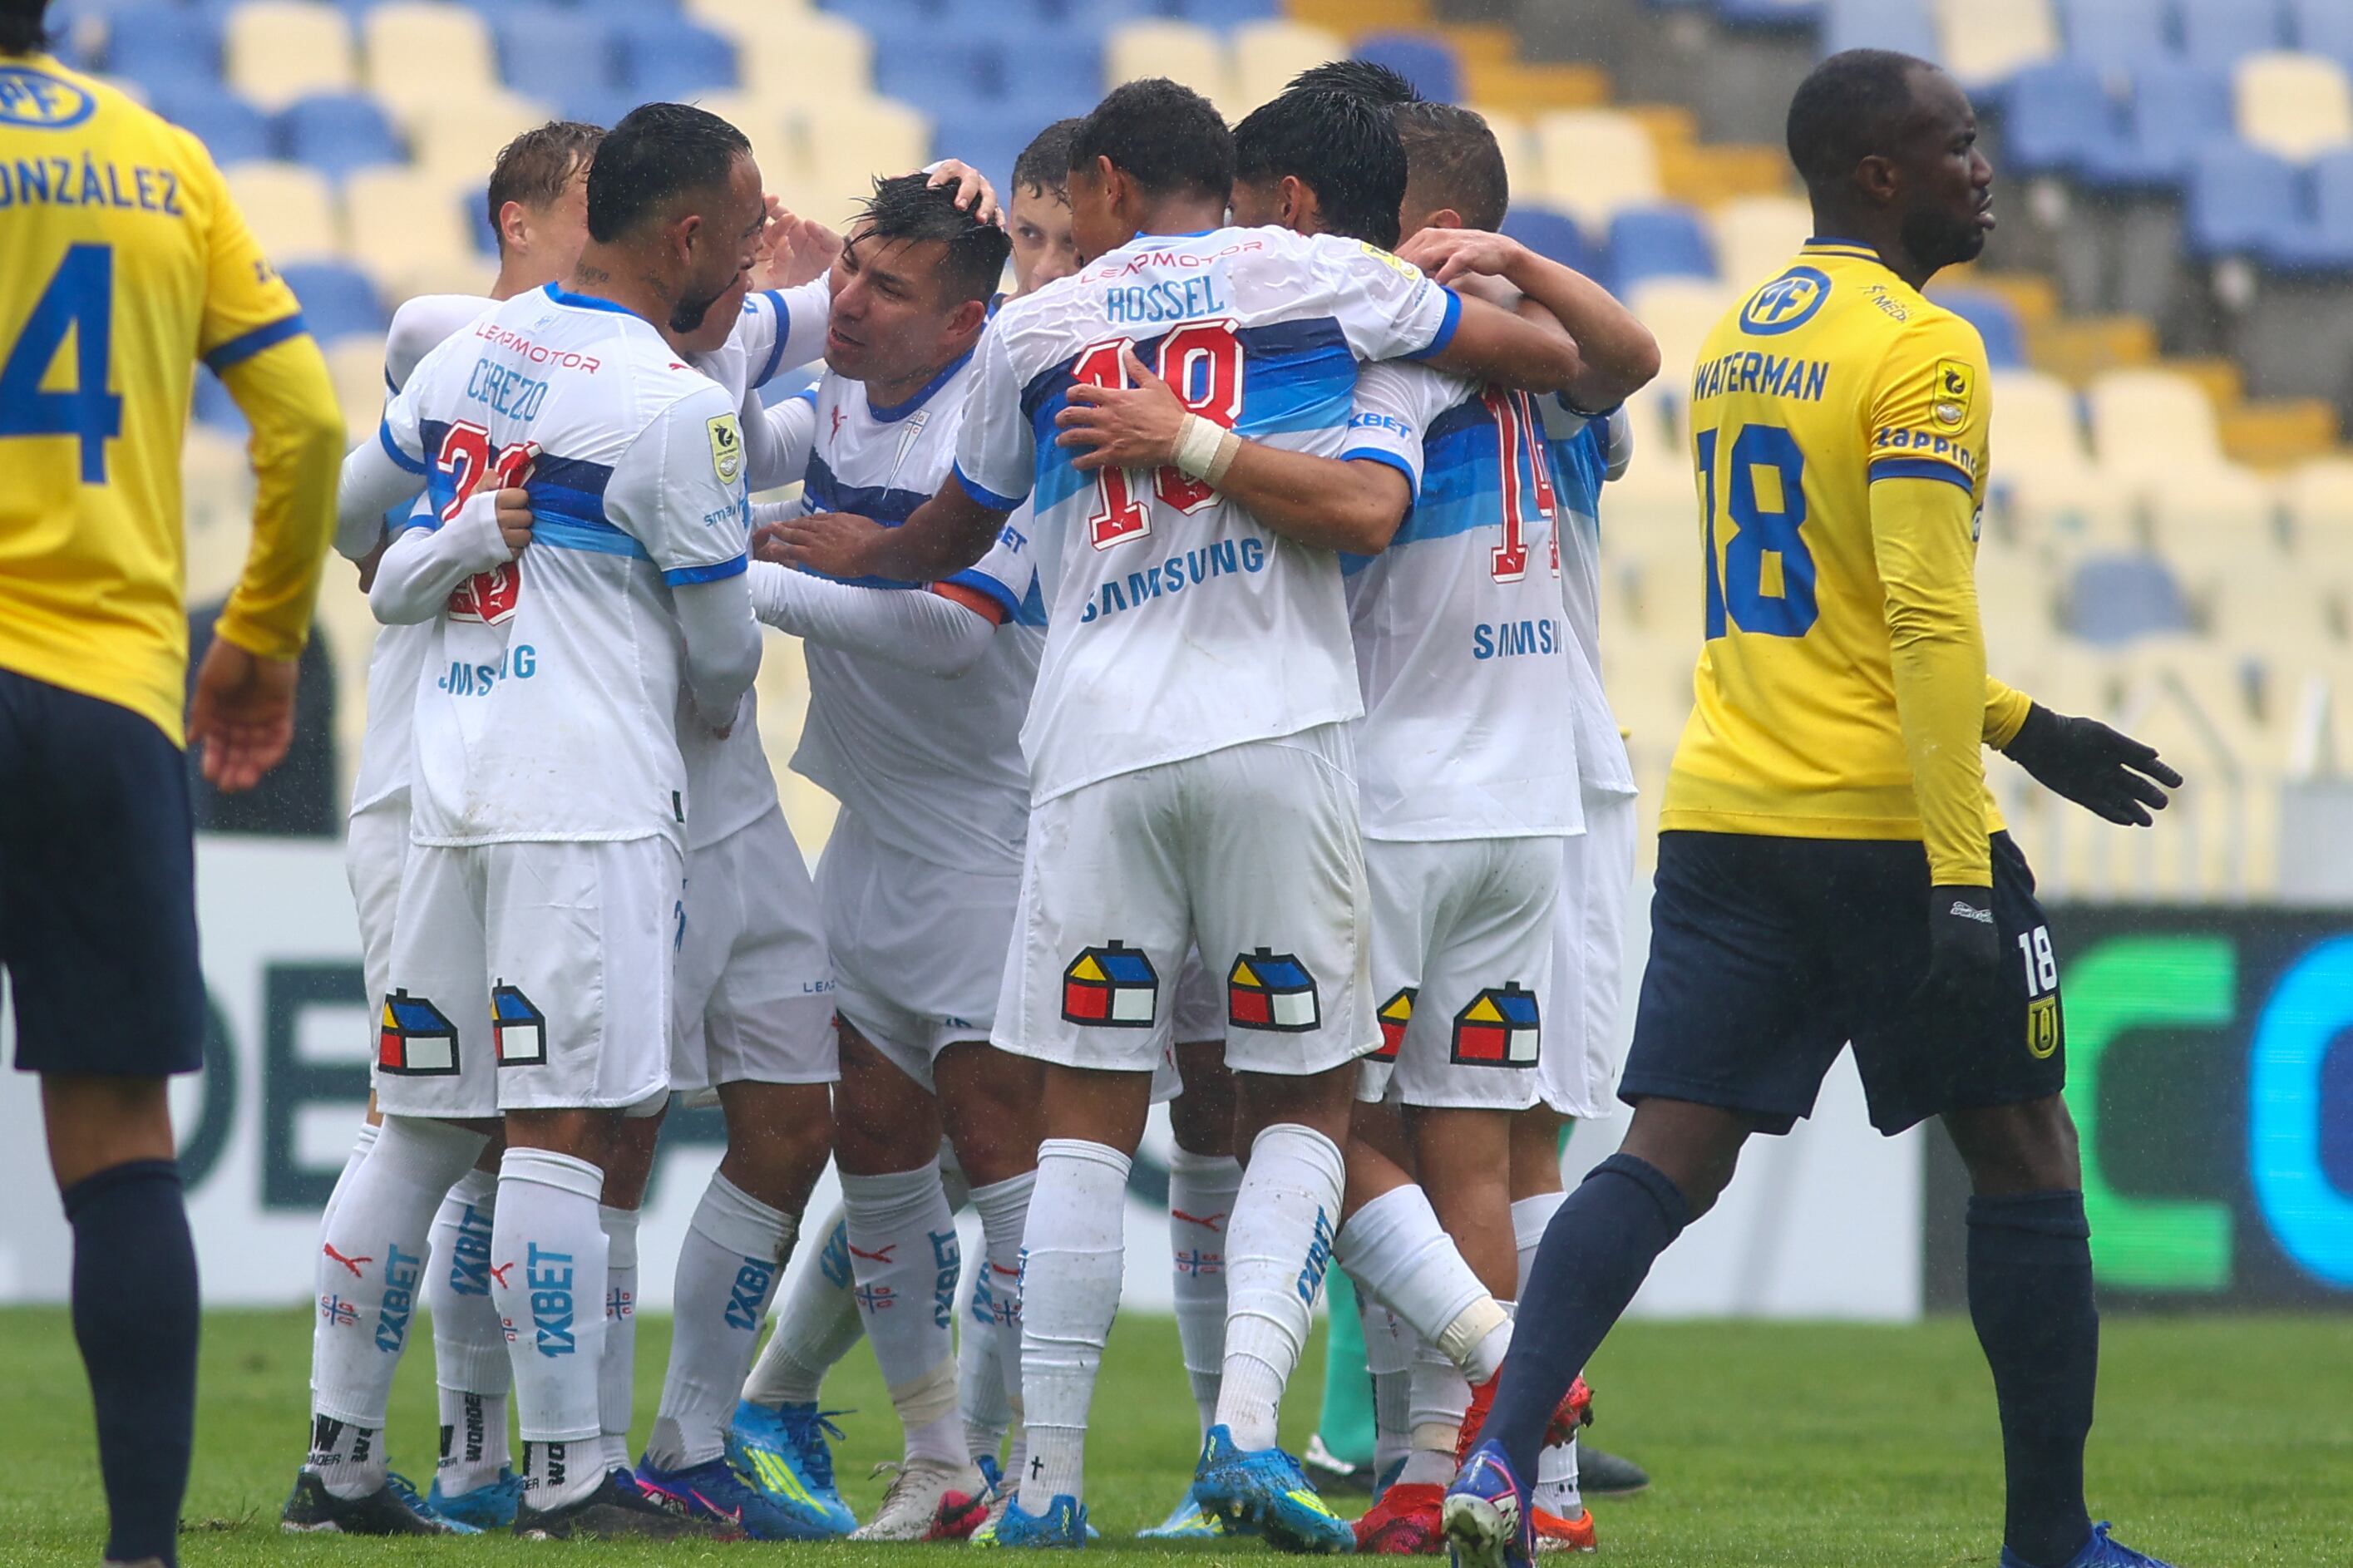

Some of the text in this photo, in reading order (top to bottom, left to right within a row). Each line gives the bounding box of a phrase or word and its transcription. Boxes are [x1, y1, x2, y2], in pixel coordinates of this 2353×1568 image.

[0, 241, 123, 484] 4
[1693, 351, 1830, 402] WATERMAN
[1080, 537, 1265, 624] SAMSUNG
[1697, 422, 1819, 642] 18
[2018, 925, 2058, 998] 18
[374, 1243, 420, 1354] 1XBET
[527, 1242, 575, 1358] 1XBET
